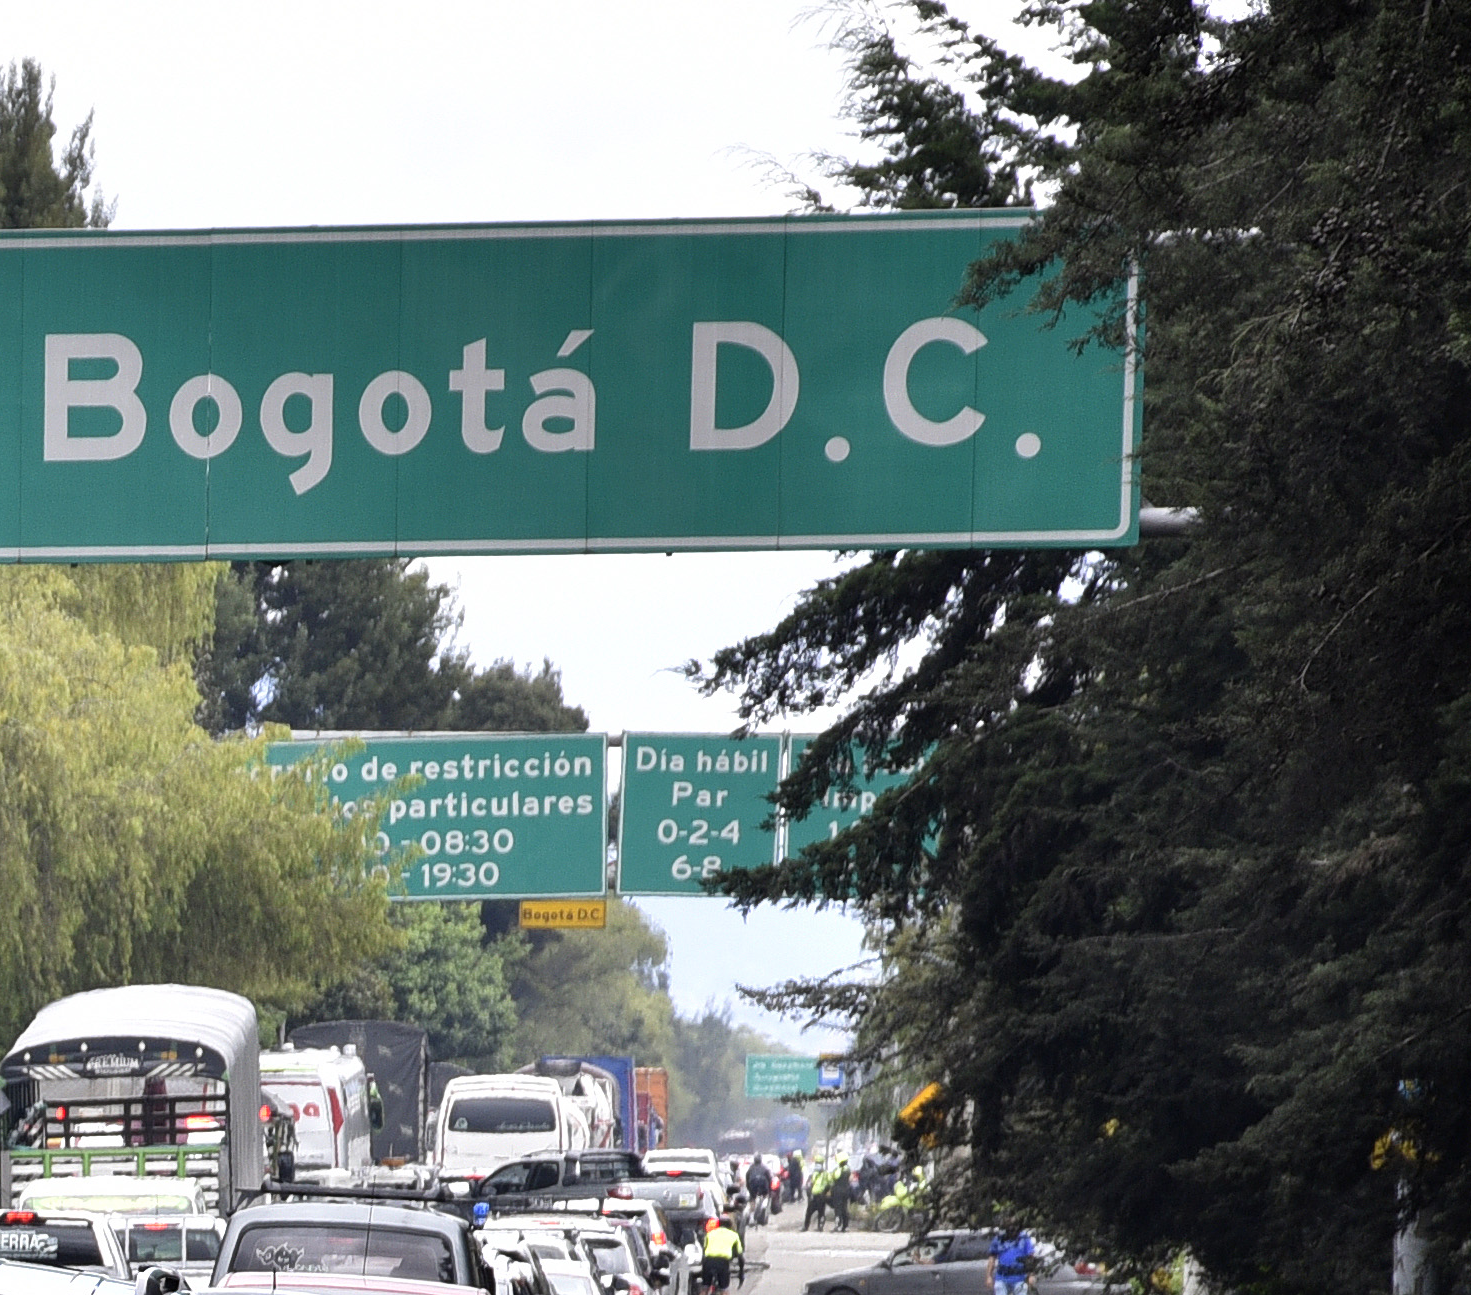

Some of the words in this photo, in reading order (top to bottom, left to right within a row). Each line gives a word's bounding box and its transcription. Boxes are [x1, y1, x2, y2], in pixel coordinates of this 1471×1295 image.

[42, 328, 597, 497] Bogotá
[688, 316, 1043, 463] D.C.
[361, 755, 398, 782] de
[409, 750, 593, 780] restricción
[636, 745, 686, 773] Día
[696, 748, 768, 774] hábil
[389, 791, 594, 825] particulares
[671, 780, 729, 808] Par
[420, 828, 515, 856] 08:30
[656, 818, 741, 846] 0-2-4
[420, 861, 500, 888] 19:30
[670, 854, 722, 881] 6-8
[522, 907, 574, 924] Bogotá
